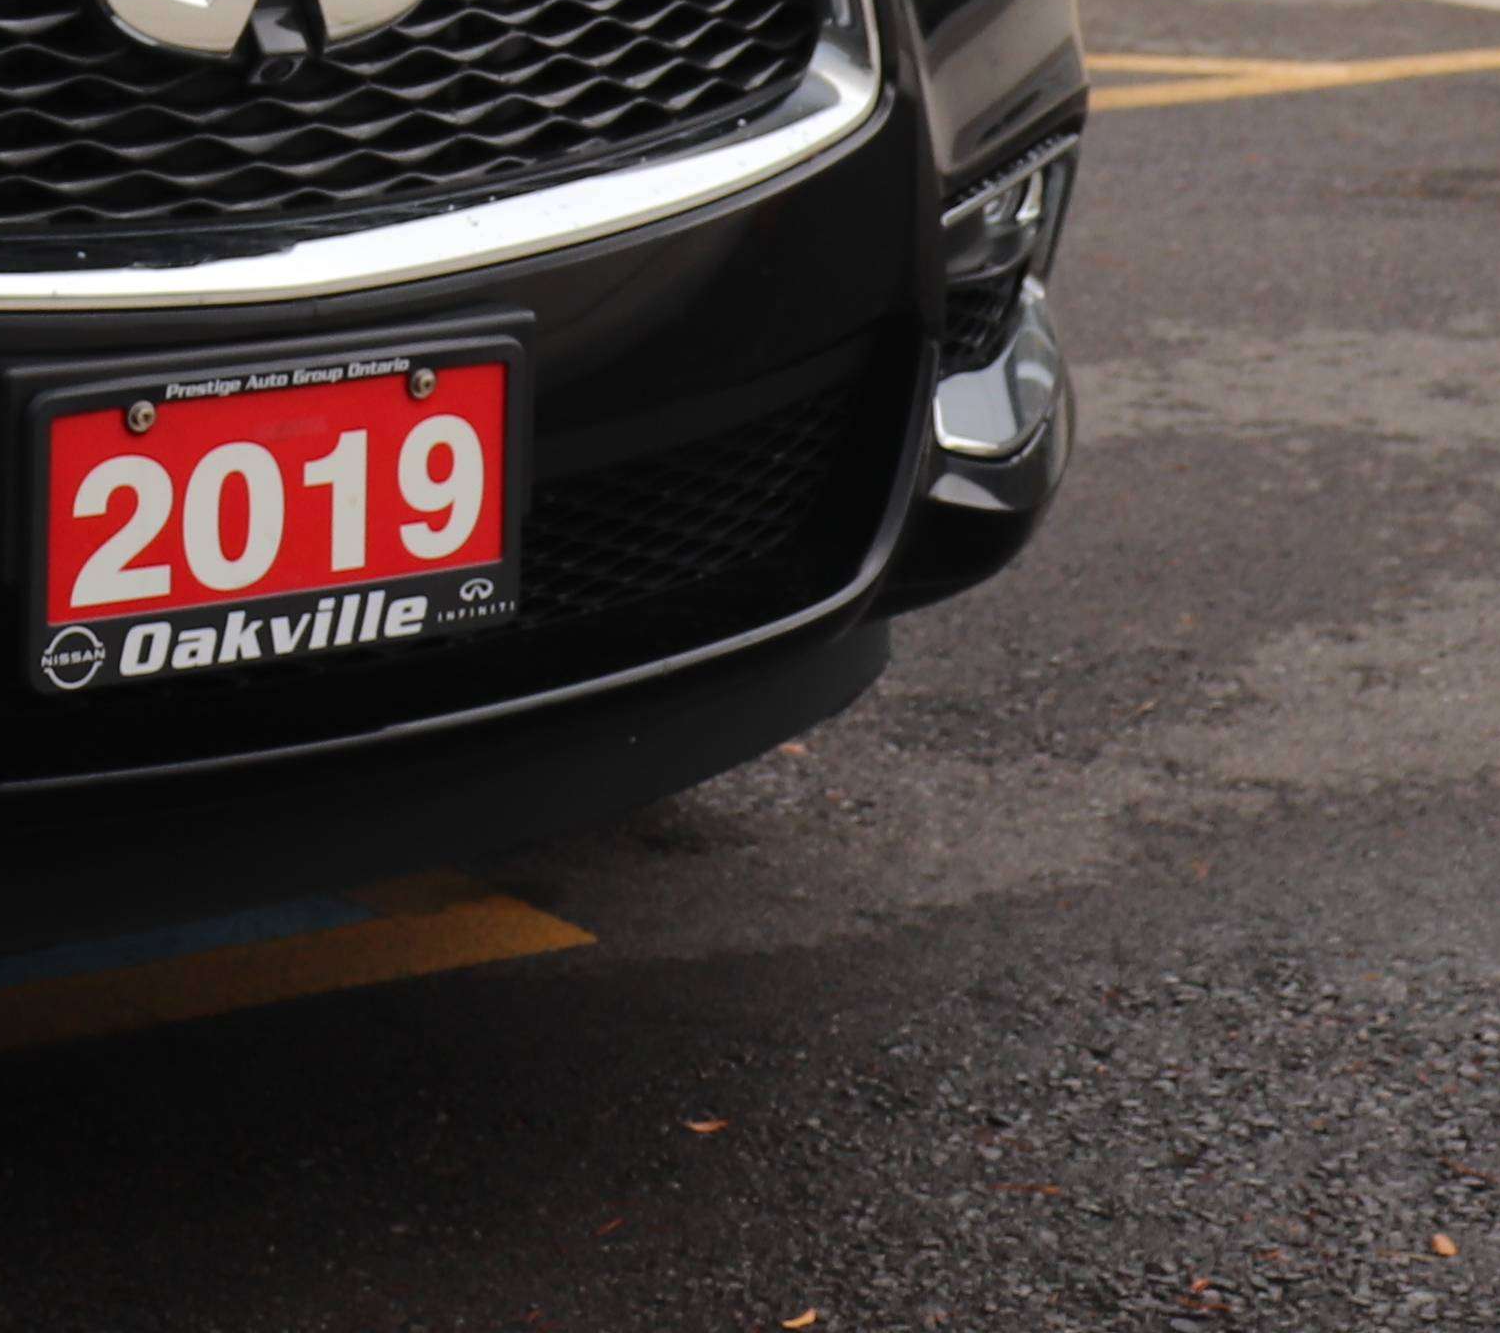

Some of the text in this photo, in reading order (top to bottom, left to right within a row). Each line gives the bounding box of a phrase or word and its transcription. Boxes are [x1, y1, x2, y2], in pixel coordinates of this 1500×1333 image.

[165, 357, 410, 400] Prestige Auto Group Ontario
[70, 414, 484, 607] 2019
[437, 600, 515, 623] INFINITI
[118, 589, 428, 678] Oakville
[40, 645, 106, 669] NISSAN
